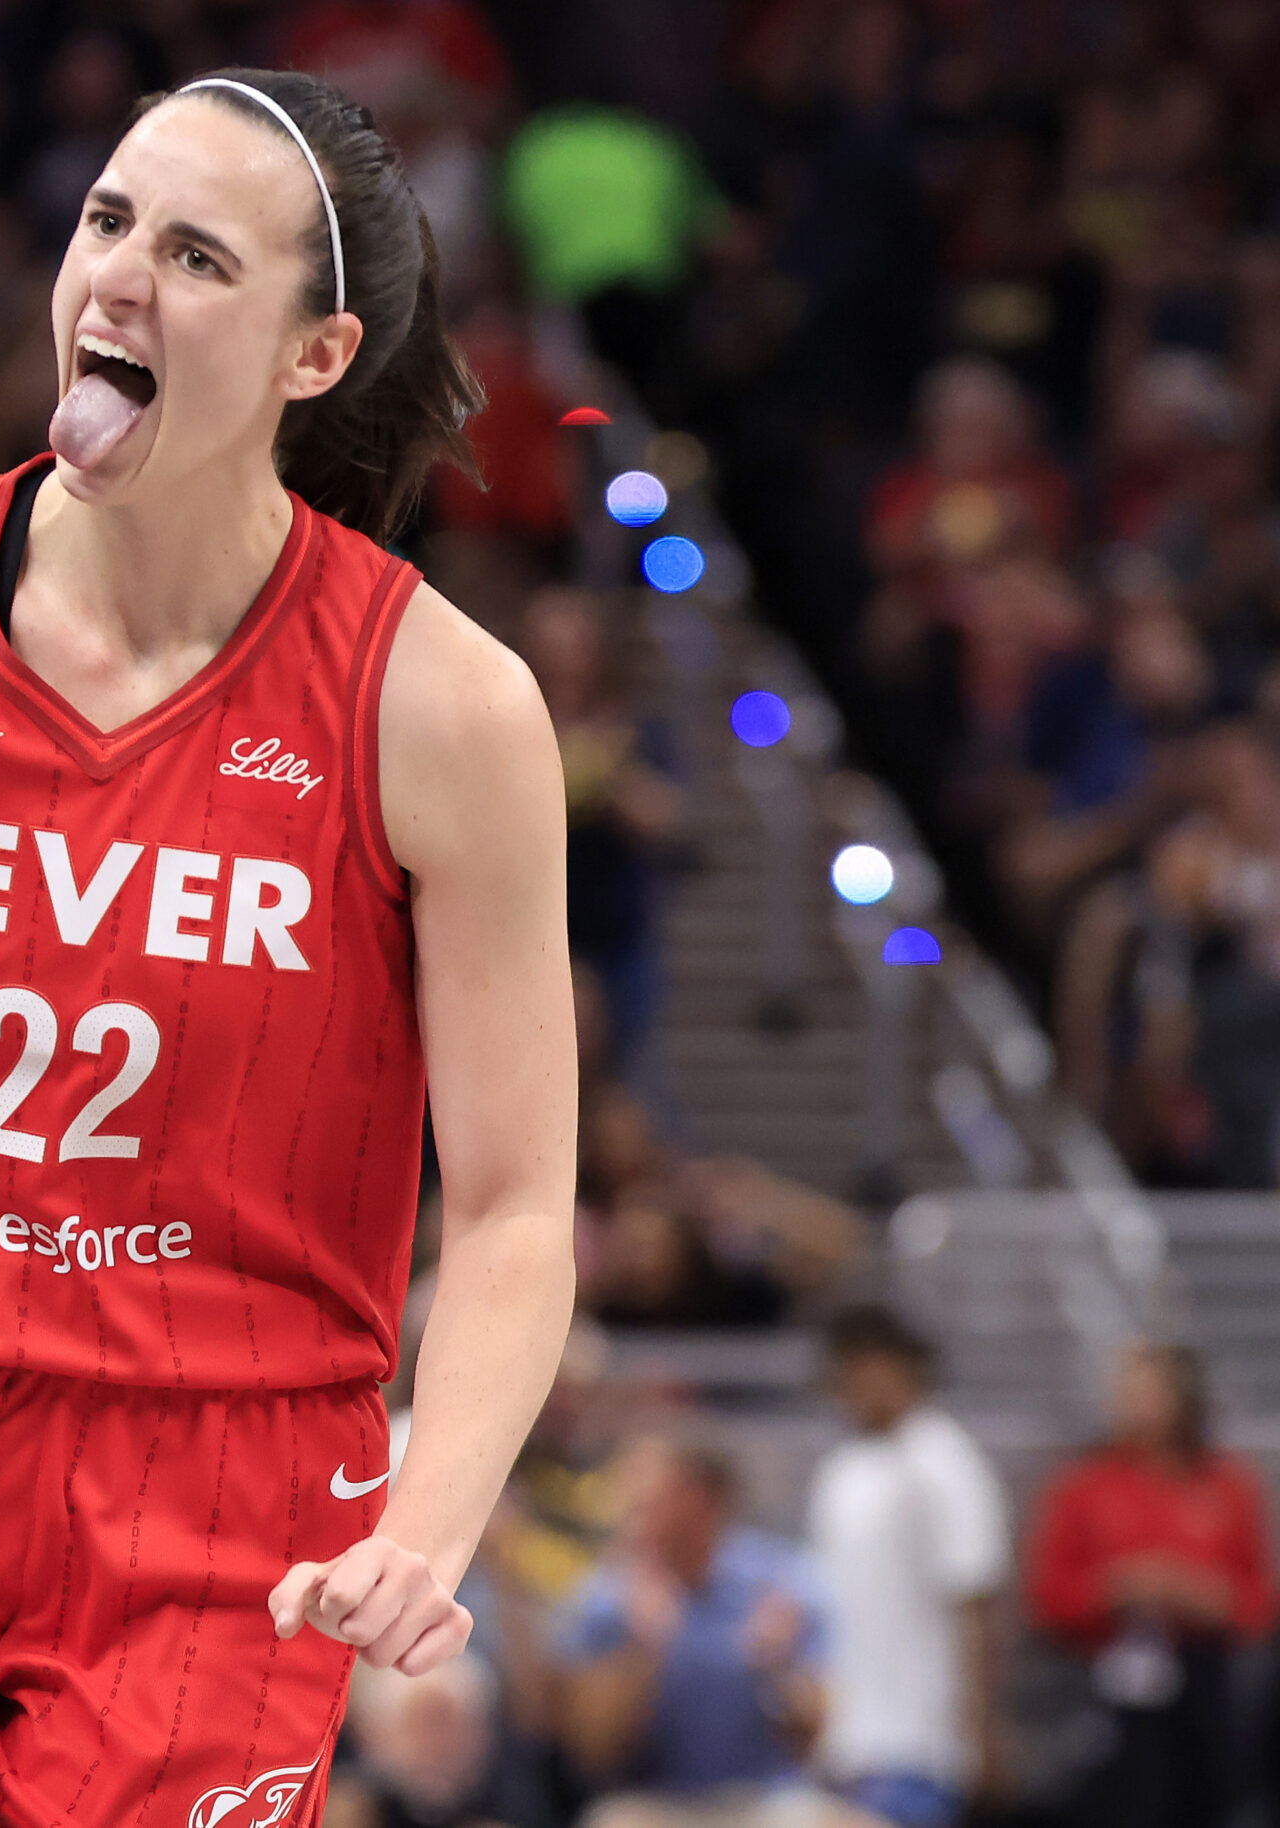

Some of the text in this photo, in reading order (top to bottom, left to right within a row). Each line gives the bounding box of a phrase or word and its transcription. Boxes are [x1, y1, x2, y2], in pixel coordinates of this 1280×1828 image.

[219, 737, 324, 800] Lilly
[155, 1263, 187, 1385] BASKETBA
[243, 1302, 262, 1363] 2012
[136, 1435, 162, 1497] 2012
[286, 1459, 301, 1523] 2020
[127, 1510, 142, 1569] 2020
[107, 1641, 129, 1701] 1999
[181, 1645, 199, 1675] ME
[134, 1683, 189, 1826] BASKETBALL
[241, 1671, 271, 1787] 2009 201
[65, 1757, 102, 1817] 2012
